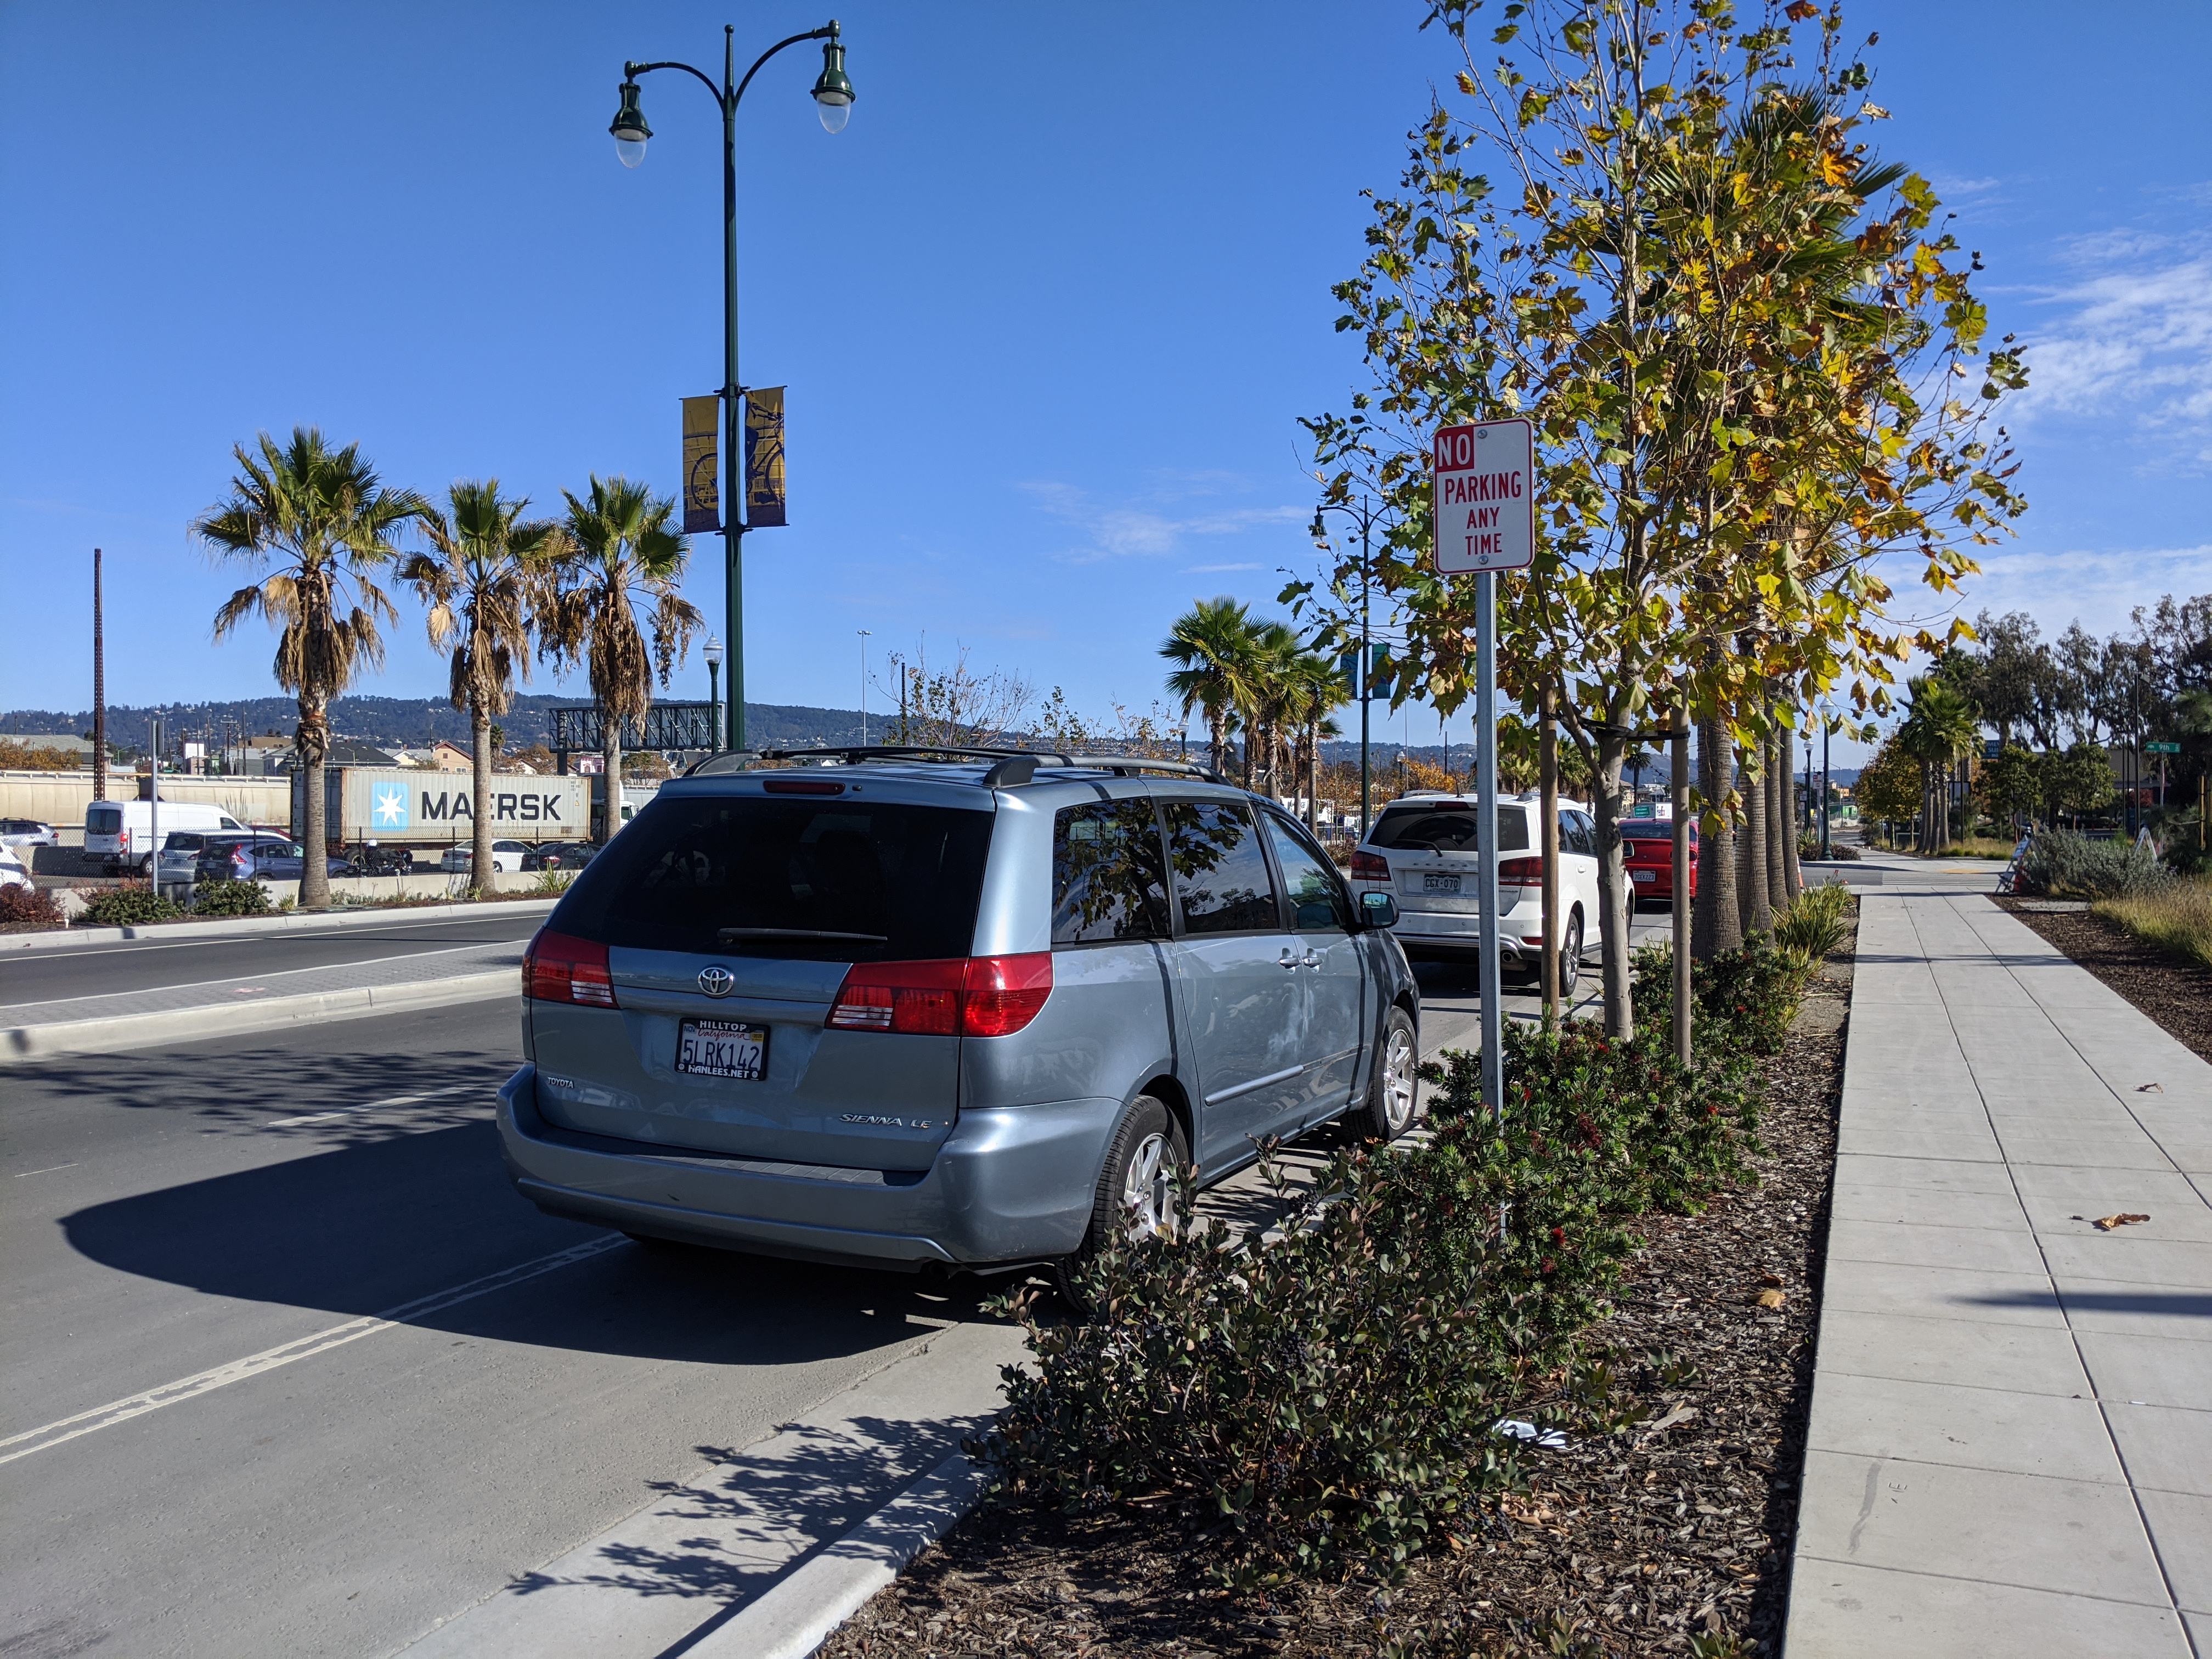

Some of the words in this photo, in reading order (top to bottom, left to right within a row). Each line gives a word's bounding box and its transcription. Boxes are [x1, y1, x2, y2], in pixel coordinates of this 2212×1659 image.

[1438, 433, 1470, 467] NO
[1445, 471, 1521, 505] PARKING
[1466, 507, 1500, 529] ANY
[1465, 533, 1502, 555] TIME
[421, 791, 561, 821] MARSK
[698, 1028, 751, 1041] California
[699, 1020, 747, 1031] HILLTOP
[683, 1039, 759, 1070] 5LRK142
[548, 1077, 574, 1088] TOYOTA
[688, 1064, 749, 1079] HANLEES.NET
[839, 1114, 902, 1126] SIENNA
[910, 1119, 932, 1128] LE
